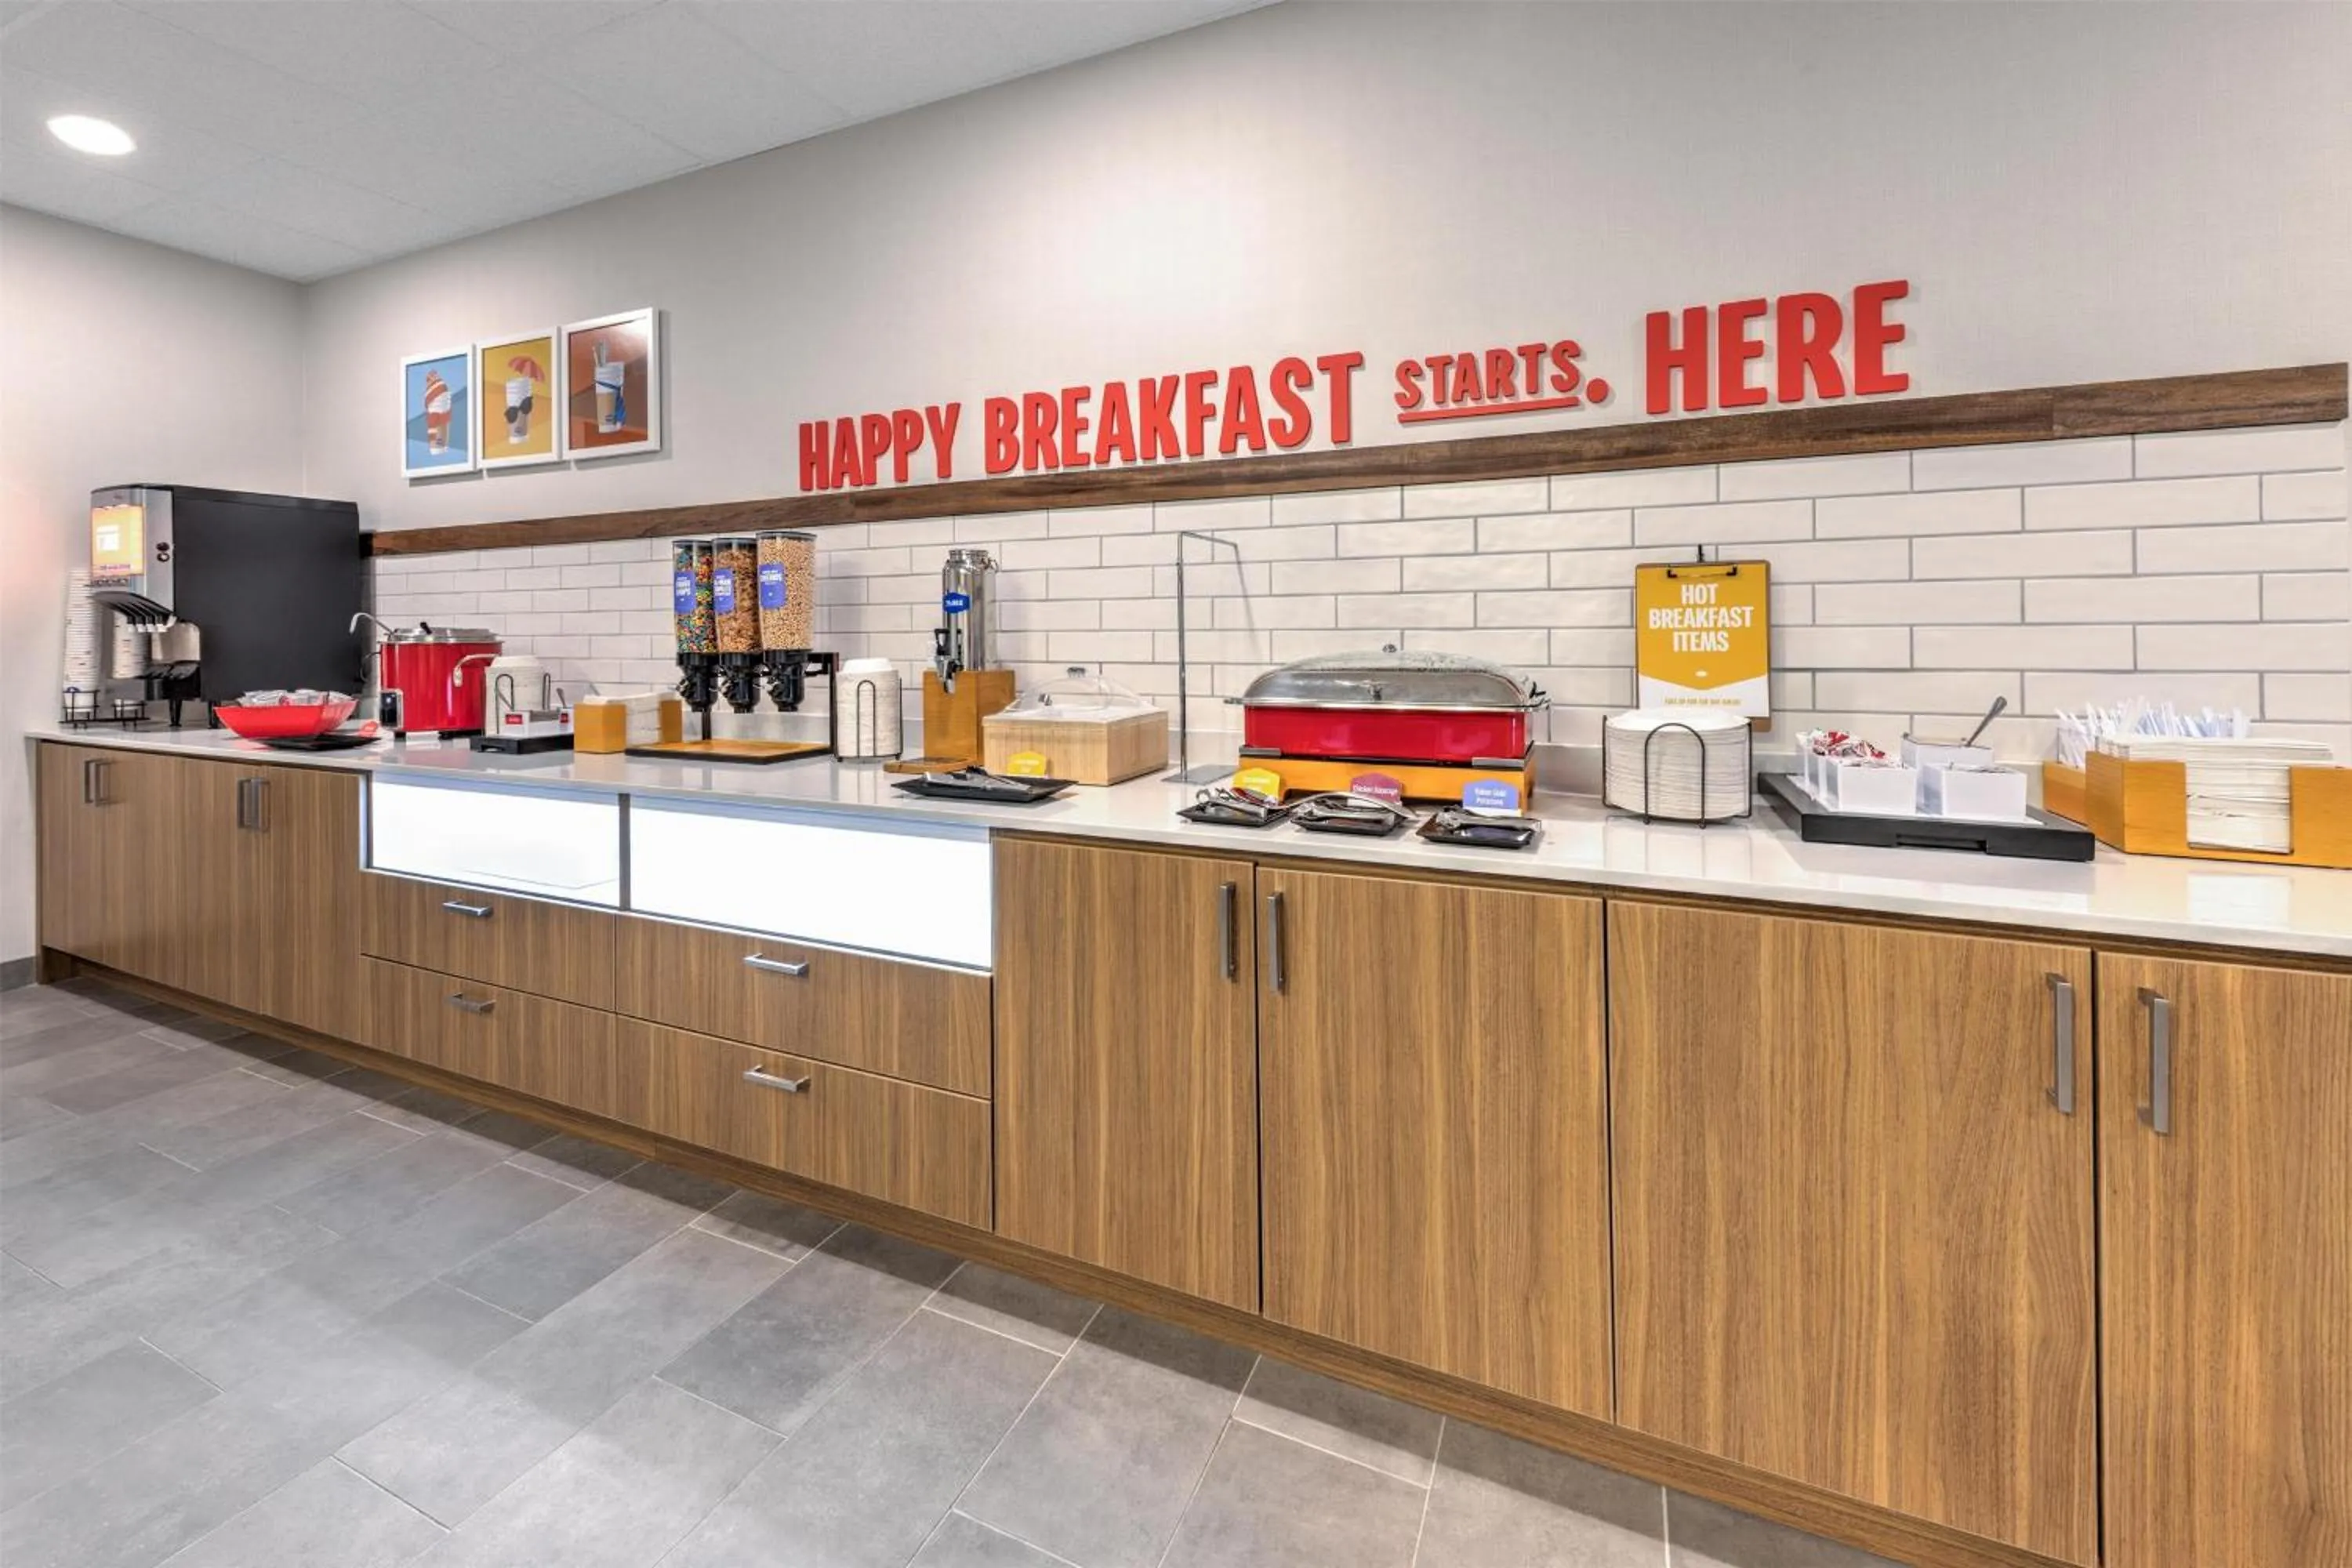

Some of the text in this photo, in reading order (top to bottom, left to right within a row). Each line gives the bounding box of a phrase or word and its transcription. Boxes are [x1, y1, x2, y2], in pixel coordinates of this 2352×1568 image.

[800, 402, 961, 492] HAPPY
[985, 351, 1364, 475] BREAKFAST
[1646, 279, 1909, 415] HERE
[1681, 583, 1719, 604] HOT
[1649, 606, 1754, 629] BREAKFAST
[1673, 630, 1730, 652] ITEMS
